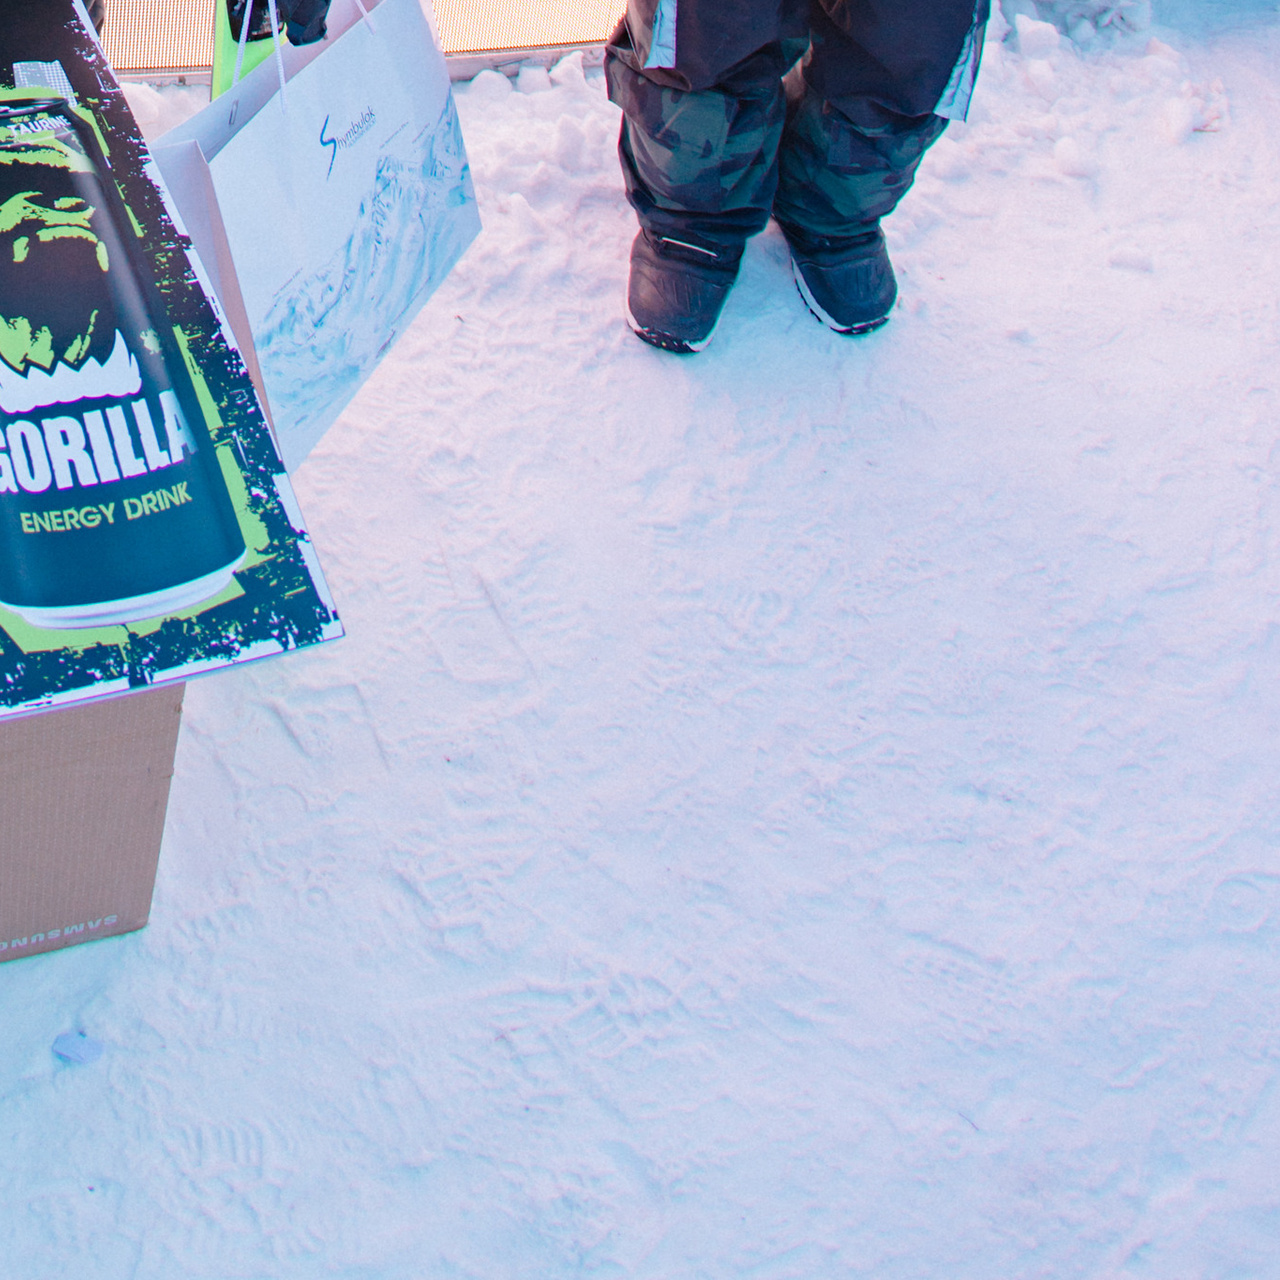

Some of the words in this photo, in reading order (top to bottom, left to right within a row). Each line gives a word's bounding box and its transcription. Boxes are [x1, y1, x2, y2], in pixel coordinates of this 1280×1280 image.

[7, 114, 72, 138] TAURINE
[20, 502, 116, 534] ENERGY
[123, 481, 193, 521] DRINK
